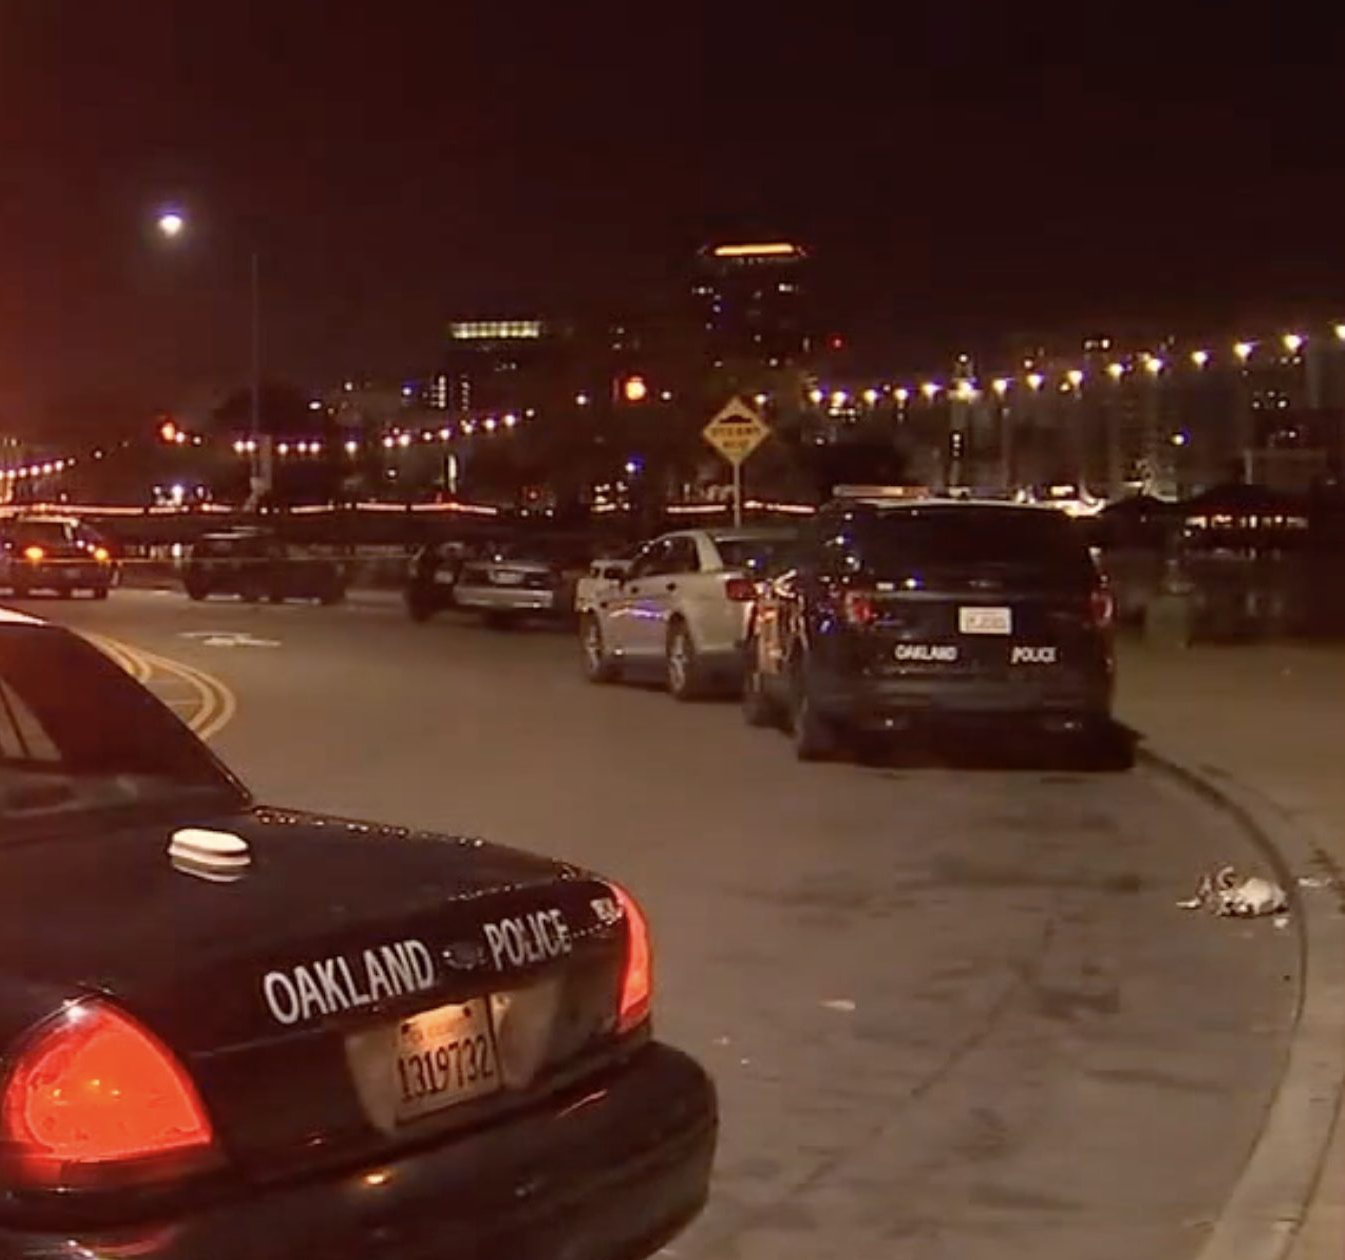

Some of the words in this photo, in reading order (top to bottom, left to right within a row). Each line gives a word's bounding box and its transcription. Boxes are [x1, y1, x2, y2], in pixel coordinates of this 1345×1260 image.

[895, 644, 957, 661] OAKLAND
[1011, 646, 1057, 664] POLICE
[263, 939, 434, 1025] OAKLAND
[483, 908, 572, 972] POLICE
[398, 1034, 495, 1103] 1319732
